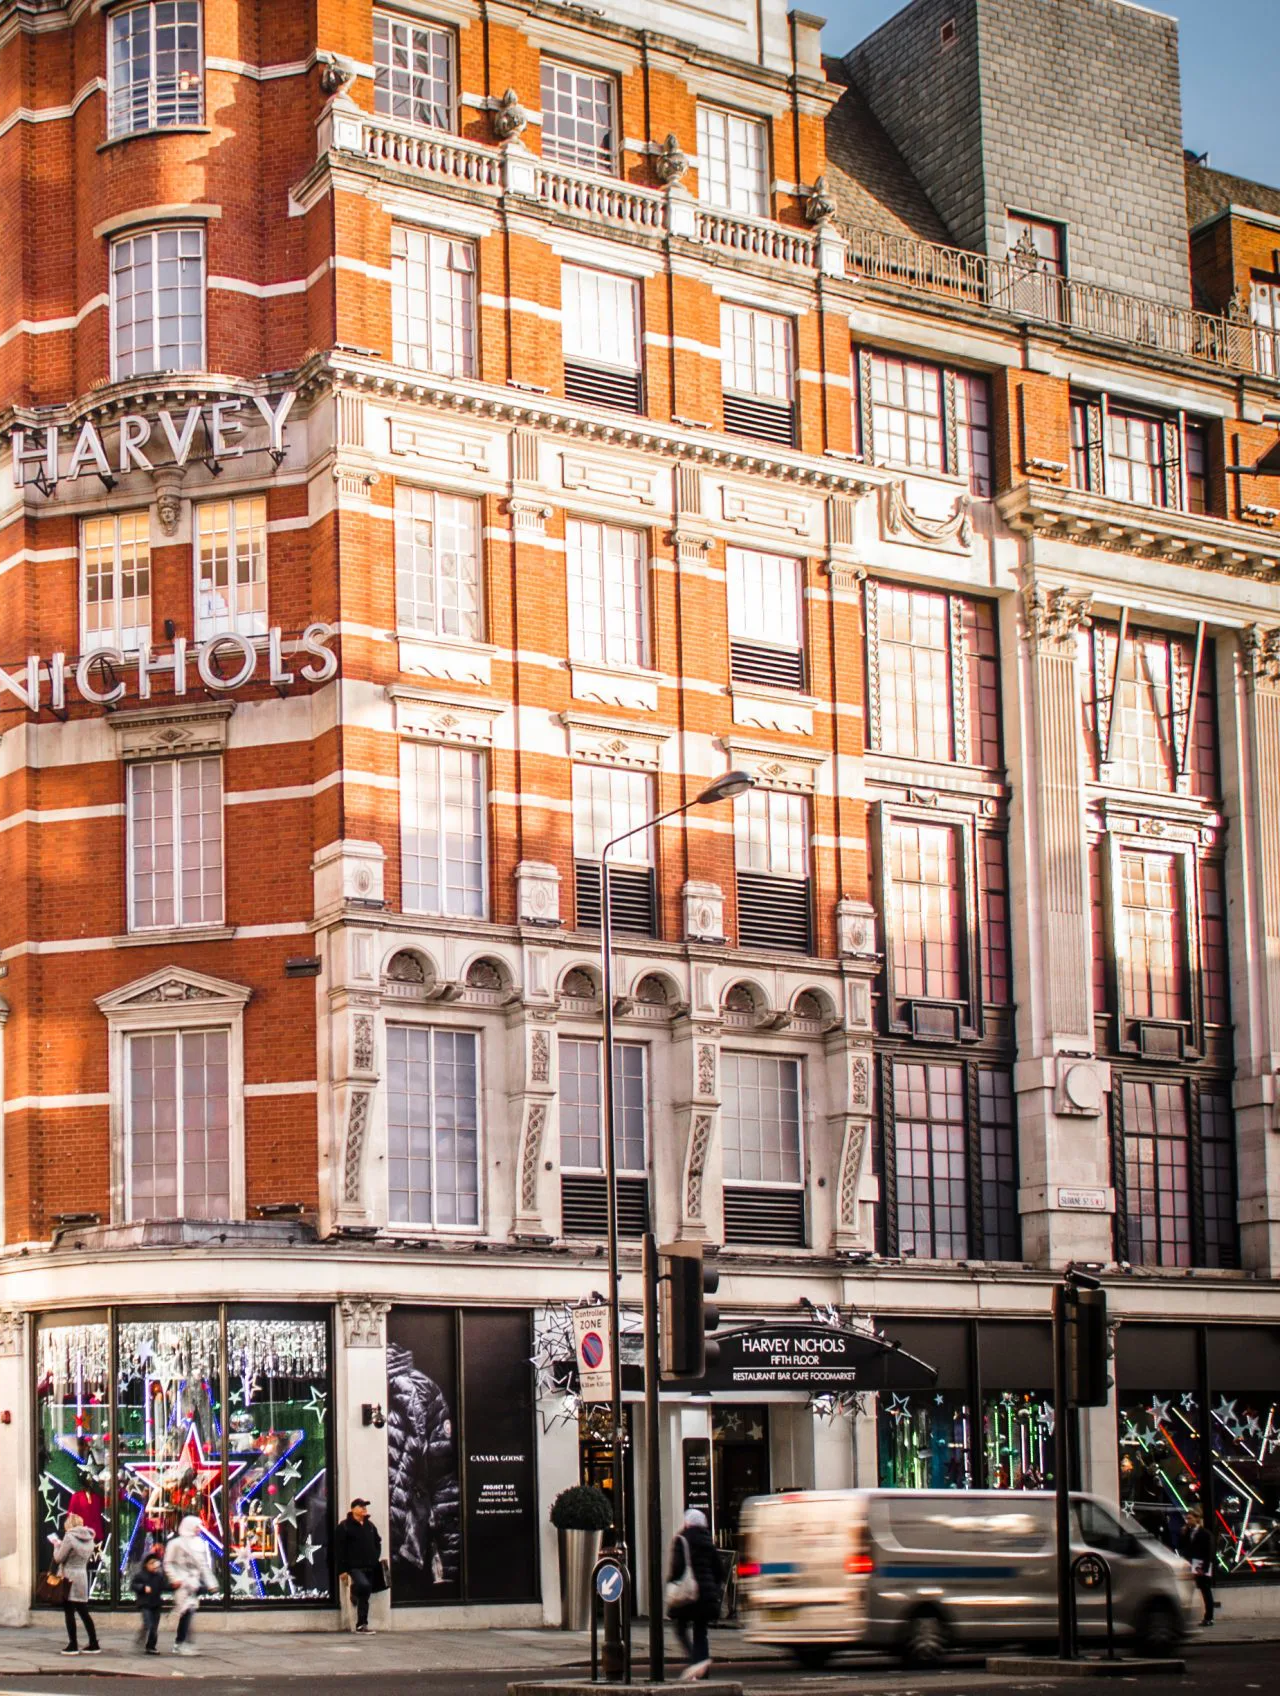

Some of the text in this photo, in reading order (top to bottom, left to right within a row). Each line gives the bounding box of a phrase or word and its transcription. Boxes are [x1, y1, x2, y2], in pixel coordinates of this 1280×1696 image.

[12, 391, 297, 488] HARVEY
[574, 1308, 607, 1318] Controlled
[580, 1318, 602, 1330] ZONE
[742, 1338, 846, 1352] HARVEY NICHOLS
[770, 1355, 820, 1365] FIFTH FLOOR
[732, 1372, 856, 1381] RESTAURANT BAR CAFE FOODMARKET
